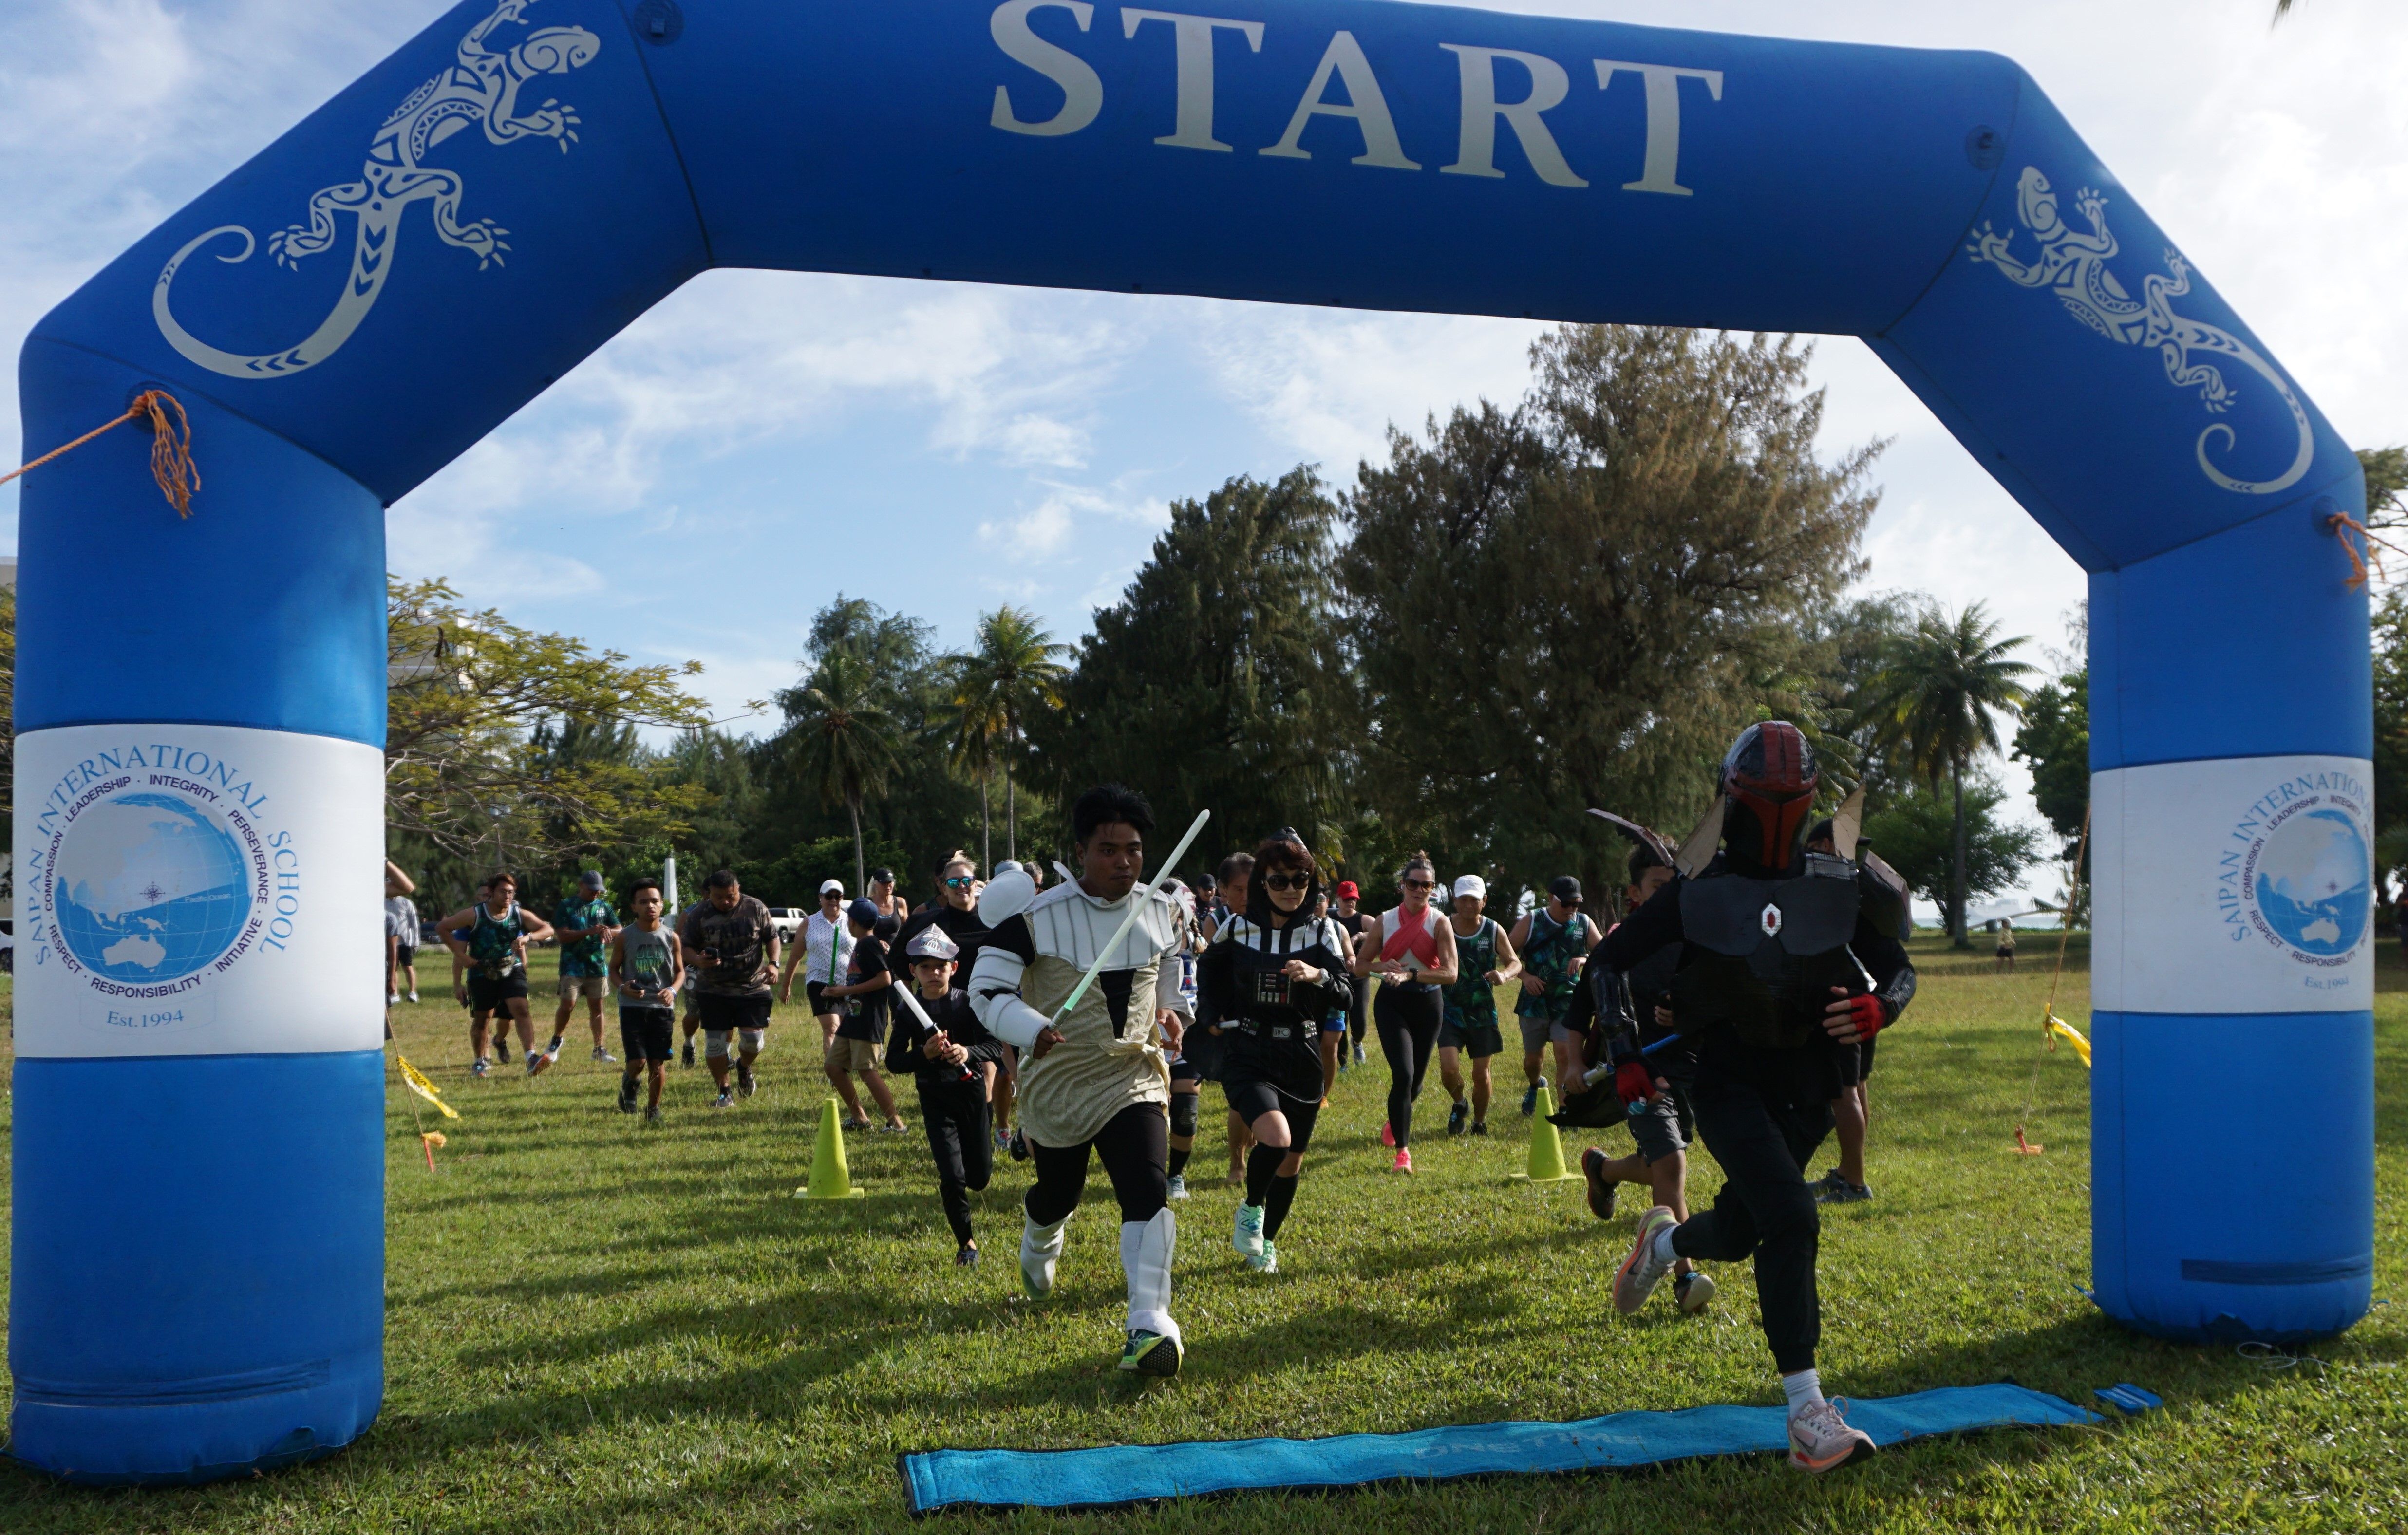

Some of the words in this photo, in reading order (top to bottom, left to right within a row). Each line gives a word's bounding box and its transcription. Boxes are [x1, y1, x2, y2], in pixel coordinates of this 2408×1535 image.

[990, 0, 1723, 196] START
[37, 744, 268, 837] INTERNATIONAL
[65, 776, 131, 823] LEADERSHIP
[149, 774, 220, 802] INTEGRITY
[44, 831, 63, 911] COMPASSION
[228, 809, 269, 904] PERSEVERANCE
[259, 831, 299, 954] SCHOOL
[2244, 837, 2265, 900] COMPASSION
[2266, 796, 2320, 831] LEADERSHIP
[2330, 795, 2361, 815] INTEGRITY
[28, 848, 51, 965] SAIPAN
[2219, 850, 2252, 942] SAIPAN
[2249, 910, 2284, 948] RESPECT
[2292, 950, 2356, 967] RESPONSIBILITY
[49, 924, 82, 974] RESPECT
[91, 974, 202, 998] RESPONSIBILITY
[215, 917, 263, 972] INITIATIVE
